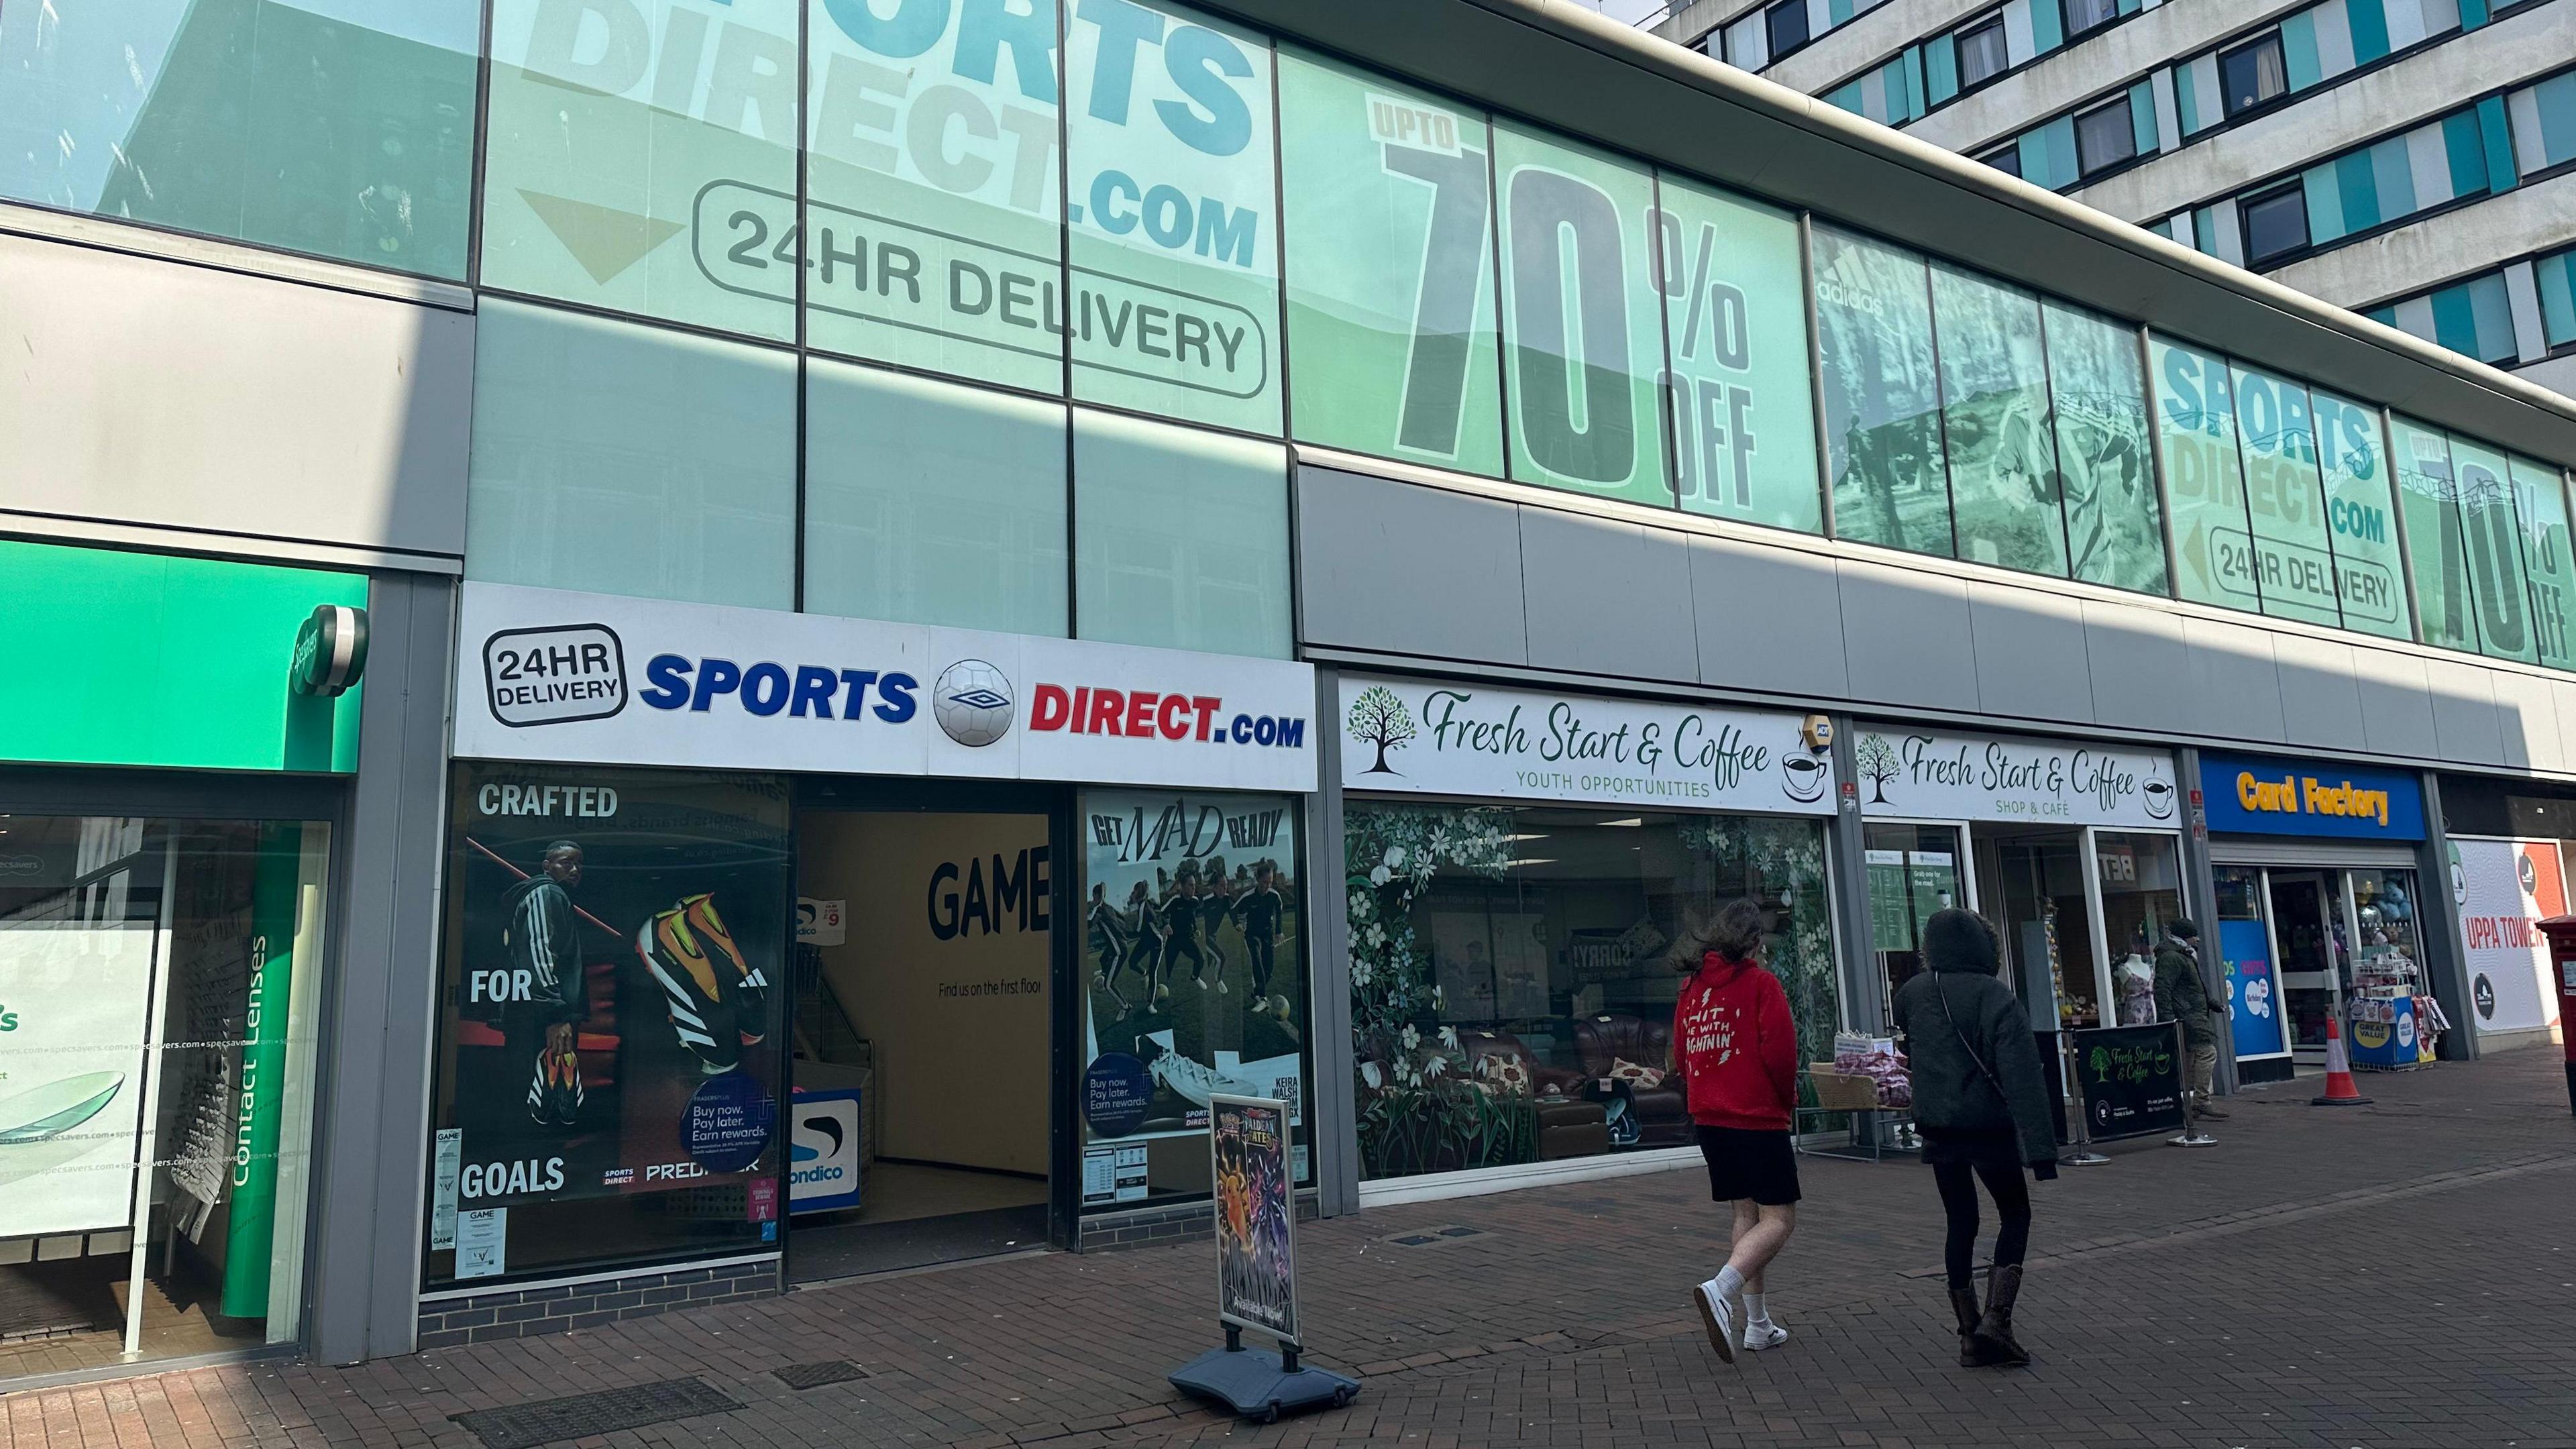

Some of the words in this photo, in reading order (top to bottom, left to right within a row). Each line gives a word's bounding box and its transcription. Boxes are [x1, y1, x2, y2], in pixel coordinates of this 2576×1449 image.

[711, 0, 1256, 157] ORTS
[727, 209, 922, 305] 24HR
[949, 260, 1246, 373] DELIVERY
[1817, 280, 1884, 317] adidas
[2163, 347, 2375, 481] SPORTS
[1654, 367, 1759, 513] OFF
[2219, 543, 2284, 588] 24HR
[496, 643, 610, 681] 24HR
[496, 678, 618, 706] DELIVERY
[638, 653, 921, 724] SPORTS
[1423, 690, 1532, 753] Fresh
[1540, 701, 1630, 763] Start
[1637, 722, 1663, 775] &
[1674, 714, 1771, 791] Coffee
[1817, 725, 1830, 736] ADT
[1516, 771, 1573, 790] YOUTH
[1580, 775, 1711, 798] OPPORTUNITIES
[1902, 735, 1976, 786] Fresh
[1982, 741, 2043, 791] Start
[2047, 757, 2065, 800] &
[2071, 749, 2137, 812] Coffee
[478, 783, 618, 817] CRAFTED
[1996, 800, 2027, 814] SHOP
[2031, 804, 2038, 815] &
[2042, 800, 2070, 816] CAFÉ
[2236, 771, 2298, 813] Card
[2302, 776, 2390, 827] Factory
[1091, 813, 1123, 847] GET
[1117, 796, 1225, 863] MAD
[1226, 808, 1284, 849] READY
[927, 845, 1050, 941] GAME
[2465, 916, 2501, 950] UPPA
[242, 934, 266, 1046] Lenses
[470, 969, 533, 1003] FOR
[939, 981, 957, 997] Find
[959, 984, 969, 996] us
[971, 983, 982, 996] on
[983, 979, 999, 995] the
[1000, 979, 1019, 994] first
[1700, 1021, 1729, 1033] WITH
[2359, 1022, 2385, 1032] GREAT
[2359, 1030, 2386, 1039] VALUE
[1686, 1031, 1735, 1055] IGHTNIN'
[2111, 1047, 2133, 1065] Fresh
[2134, 1045, 2153, 1063] Start
[1090, 1079, 1107, 1090] Buy
[1108, 1077, 1128, 1087] now.
[1275, 1077, 1298, 1088] KEIRA
[2126, 1063, 2149, 1085] Coffee
[1090, 1089, 1107, 1101] Pay
[1108, 1087, 1130, 1097] later.
[1090, 1099, 1111, 1110] Earn
[1112, 1095, 1148, 1108] rewards.
[1271, 1087, 1298, 1098] WALSH
[232, 1058, 257, 1187] Contact
[692, 1118, 715, 1131] Pay
[716, 1116, 745, 1128] later.
[693, 1106, 715, 1120] Buy
[717, 1105, 744, 1116] now.
[437, 1132, 460, 1140] GAME
[692, 1130, 719, 1142] Earn
[720, 1125, 767, 1140] rewards.
[461, 1157, 565, 1199] GOALS
[604, 1168, 634, 1177] SPORTS
[604, 1176, 634, 1185] DIRECT
[470, 1210, 494, 1220] GAME
[433, 1236, 453, 1245] GAME
[1234, 1295, 1264, 1317] Available
